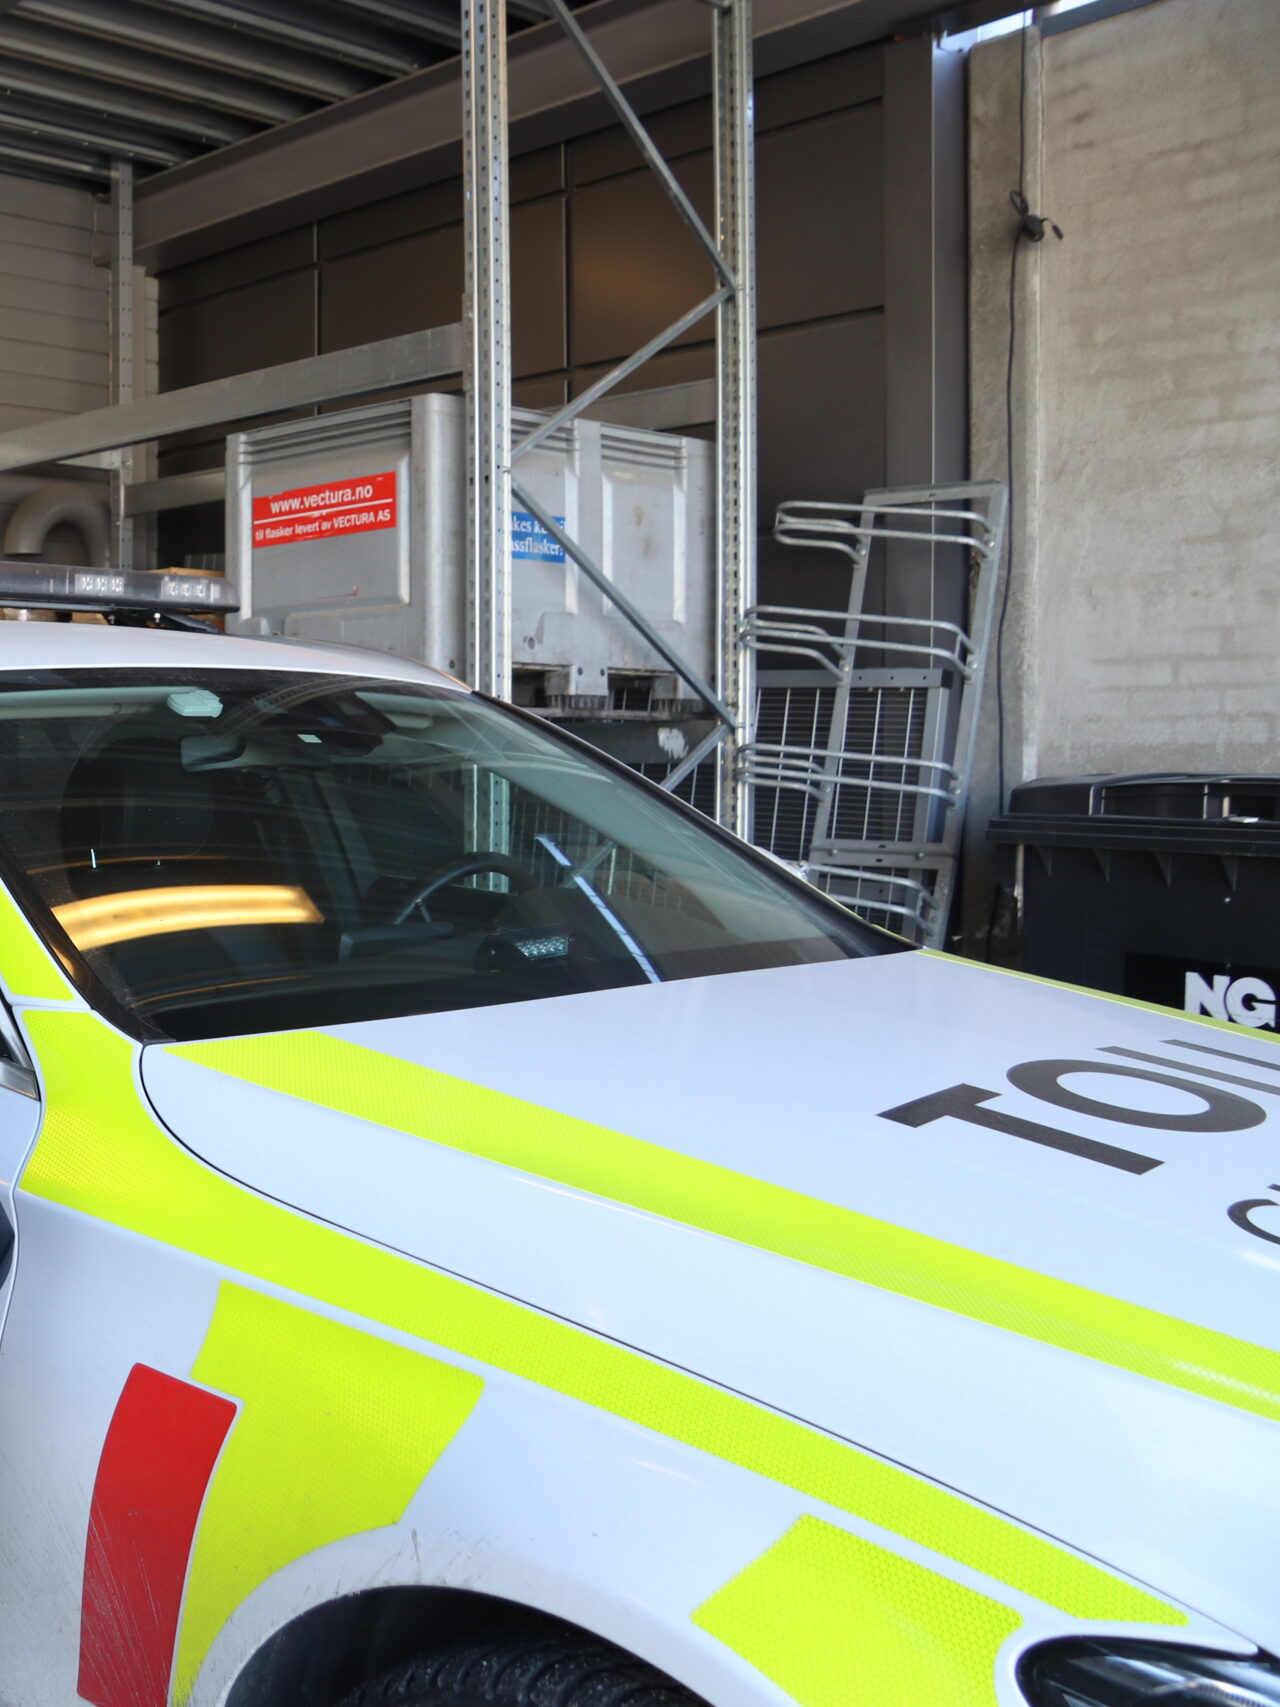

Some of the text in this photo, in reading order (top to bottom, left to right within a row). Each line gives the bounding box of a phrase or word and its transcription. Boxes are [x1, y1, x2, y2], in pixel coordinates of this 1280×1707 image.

[270, 485, 373, 514] www.vectura.no
[255, 508, 392, 541] til flasker levert av VECTURA AS
[1184, 971, 1277, 1029] NG
